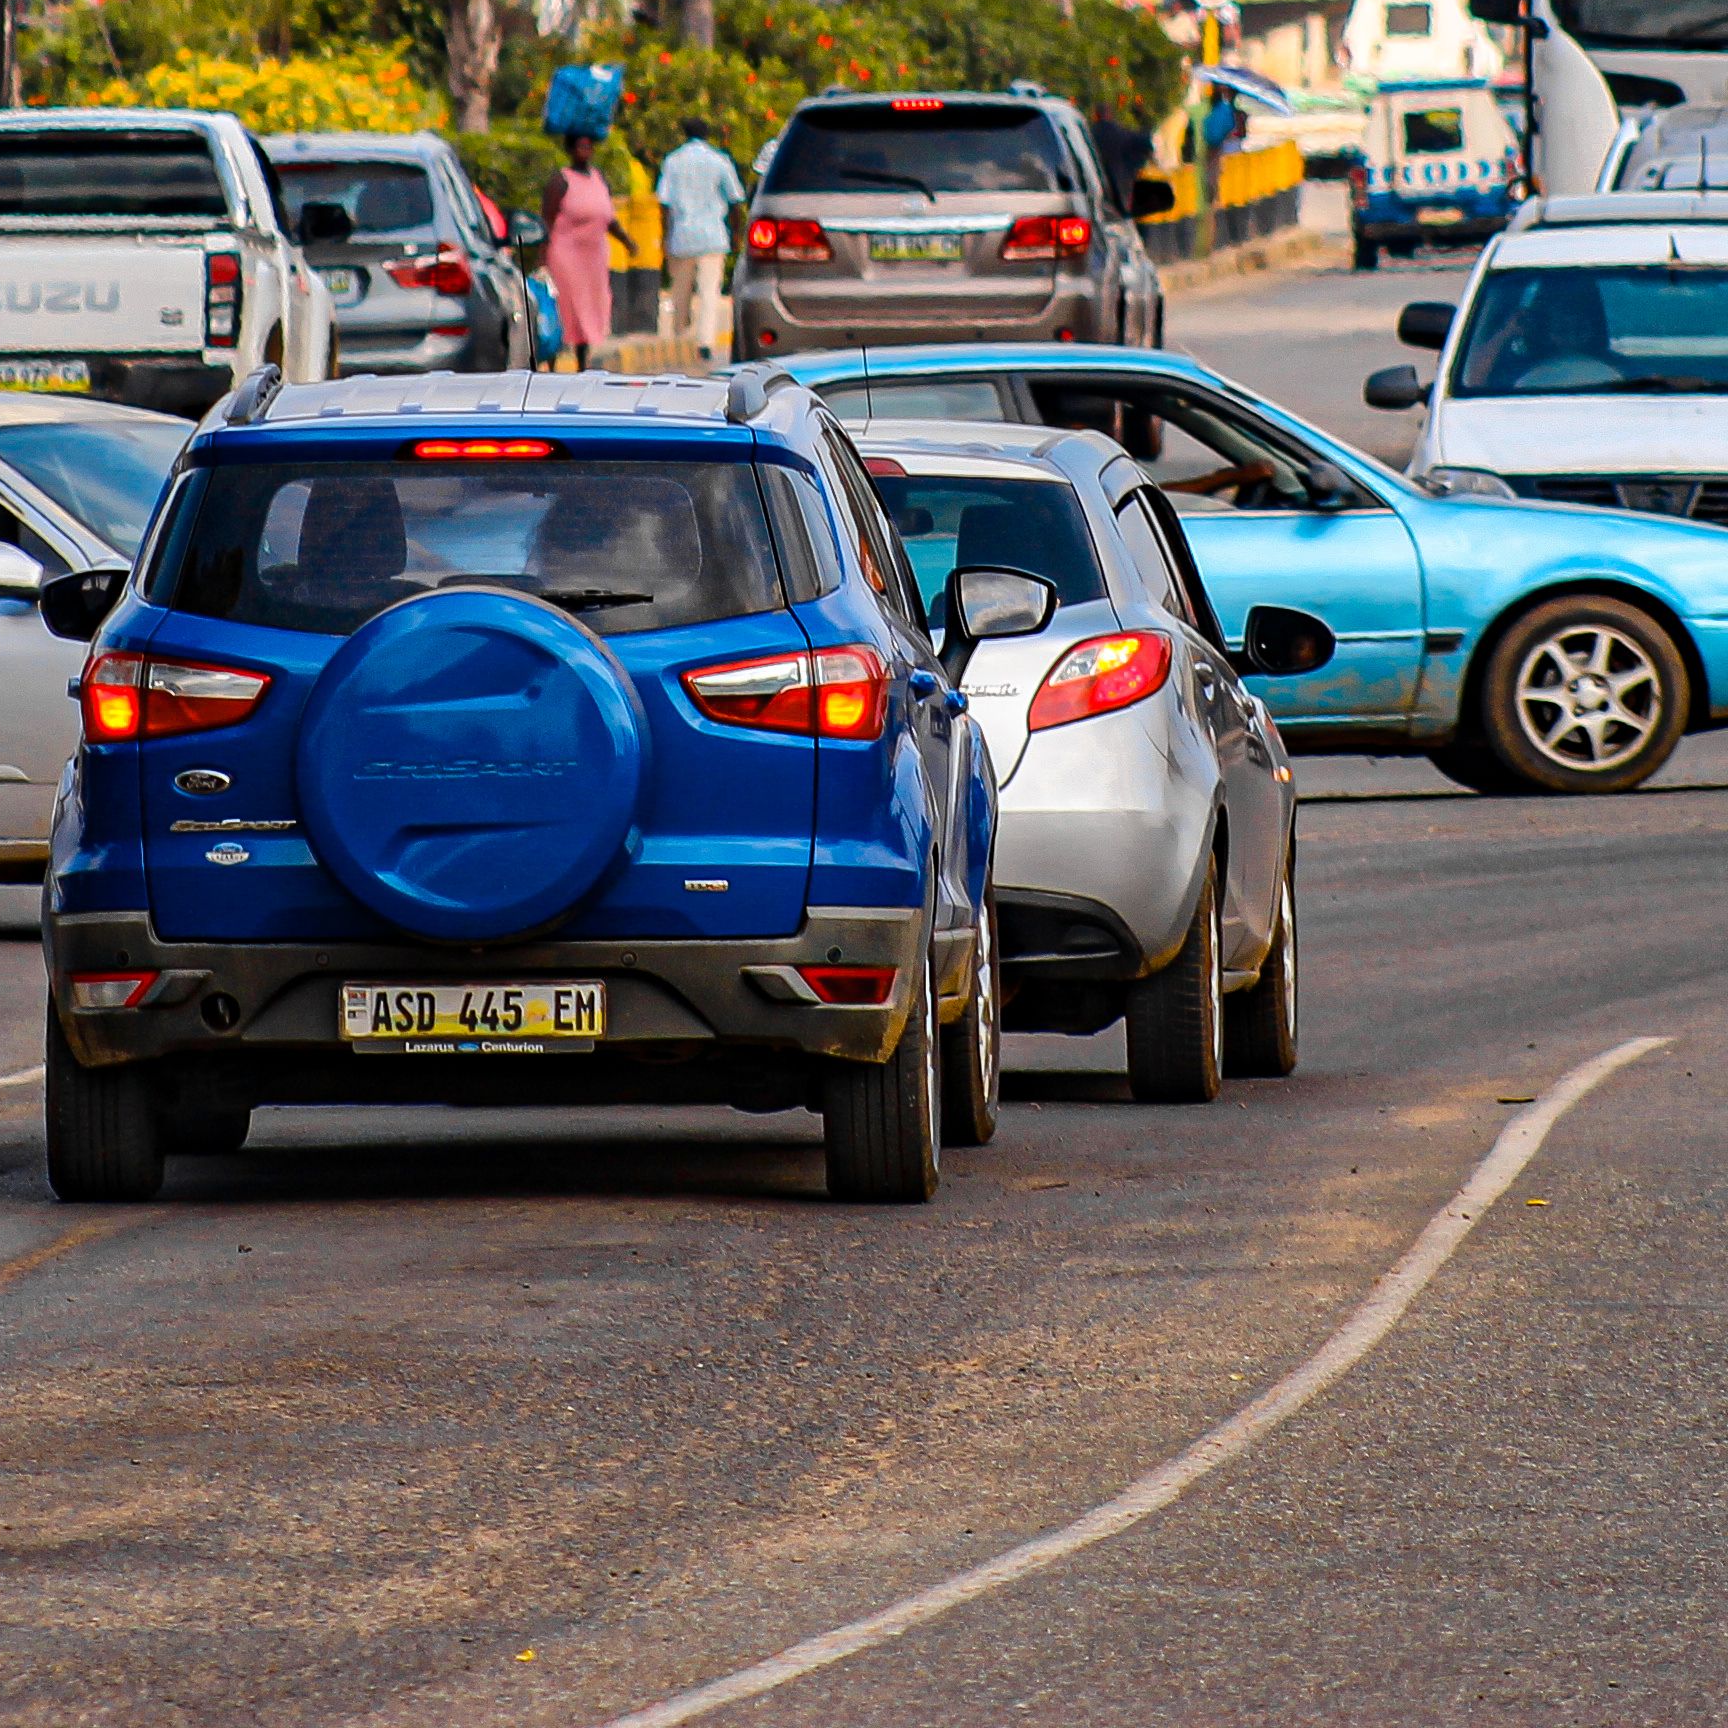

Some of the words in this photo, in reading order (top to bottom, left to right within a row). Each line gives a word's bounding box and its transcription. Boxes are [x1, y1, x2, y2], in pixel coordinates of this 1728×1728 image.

[373, 990, 436, 1033] ASD
[459, 990, 523, 1033] 445
[553, 989, 596, 1032] EM
[405, 1041, 455, 1054] Lazarus
[481, 1041, 545, 1054] Centurion
